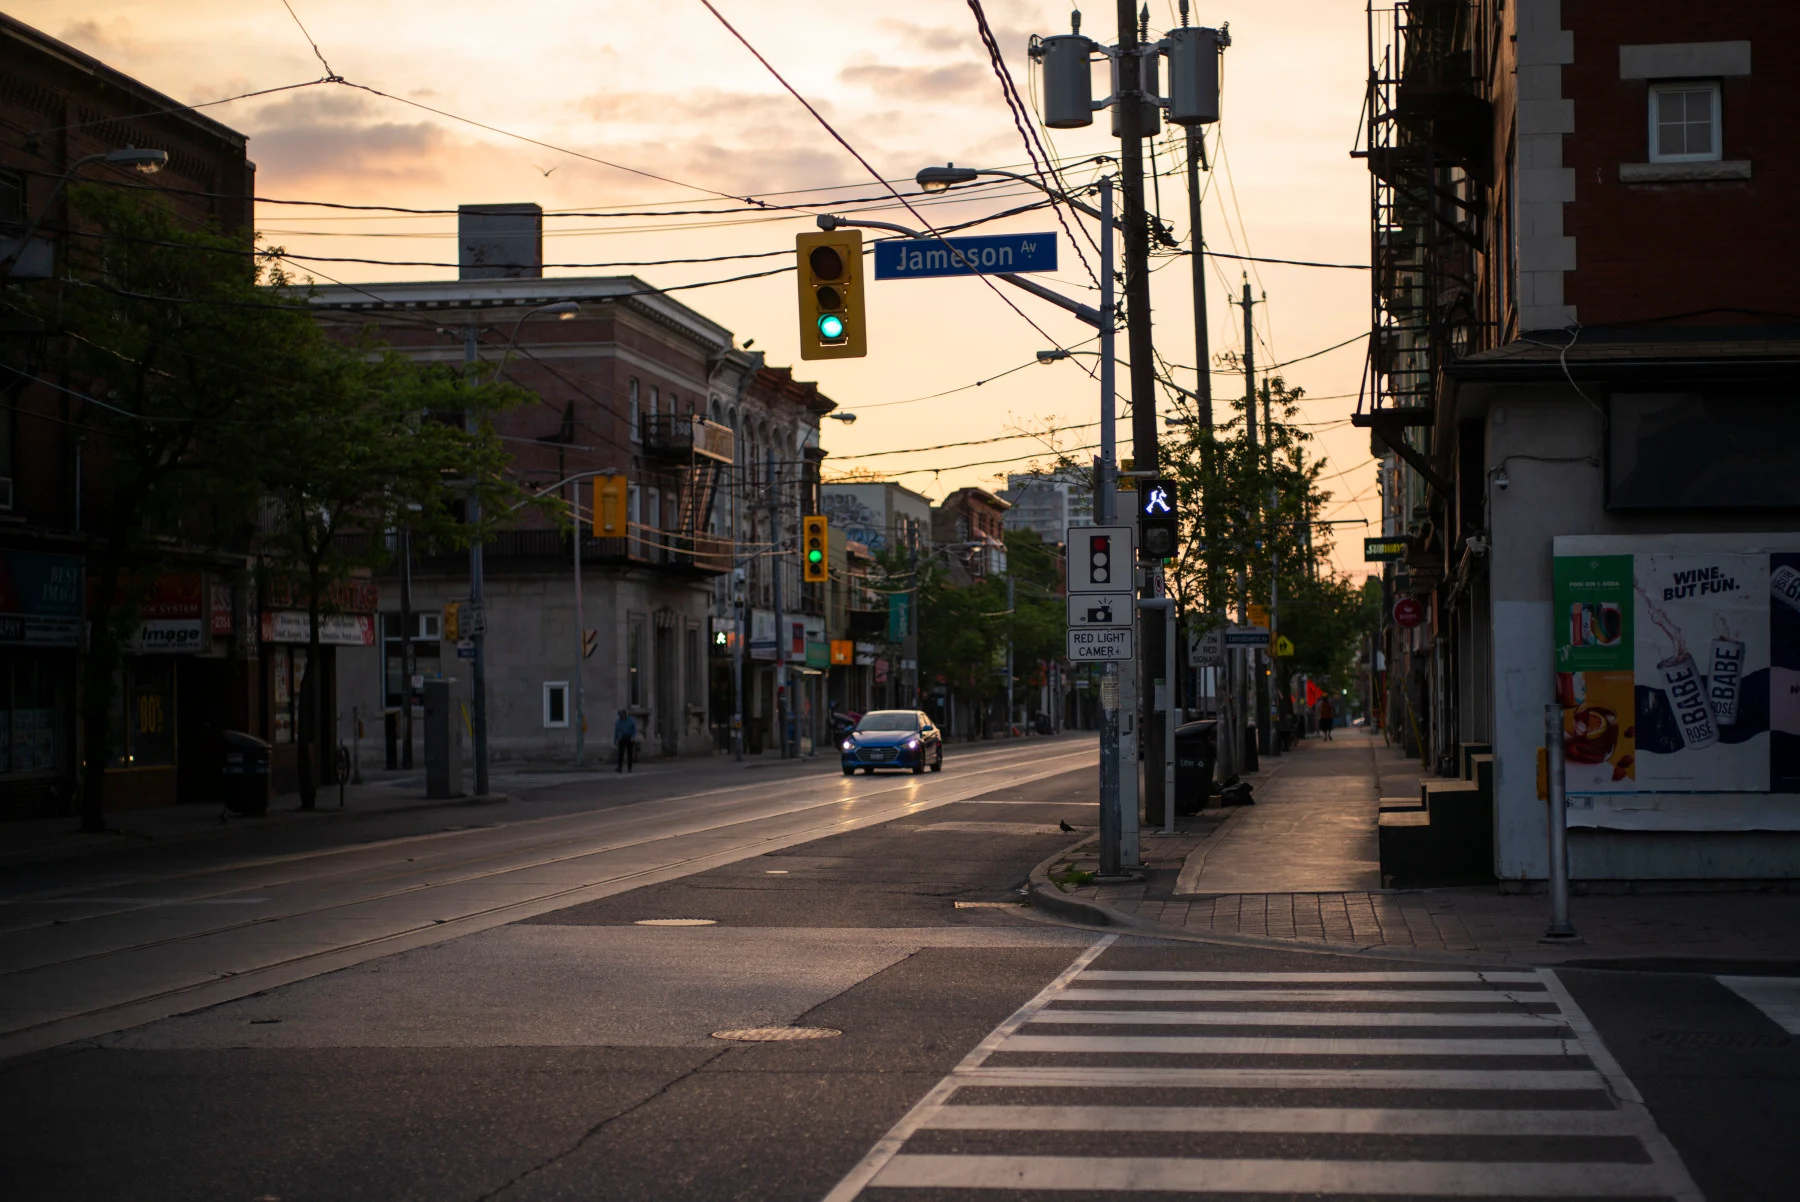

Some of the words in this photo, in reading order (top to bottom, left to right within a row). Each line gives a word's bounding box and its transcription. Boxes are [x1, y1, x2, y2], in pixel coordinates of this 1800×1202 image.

[896, 246, 1012, 271] Jameson
[1020, 240, 1037, 254] Av
[1366, 543, 1404, 555] SUBWAY
[50, 566, 78, 584] BEST
[1673, 566, 1725, 585] WINE.
[42, 582, 77, 602] IMAGE
[1663, 584, 1696, 601] BUT
[1700, 578, 1740, 595] FUN.
[159, 603, 198, 613] SYSTEM
[142, 626, 199, 643] Image
[1074, 633, 1093, 643] RED
[1097, 632, 1125, 643] LIGHT
[1207, 636, 1217, 644] ON
[1203, 646, 1217, 654] RED
[1711, 647, 1740, 700] BABE
[1666, 667, 1708, 725] BABE
